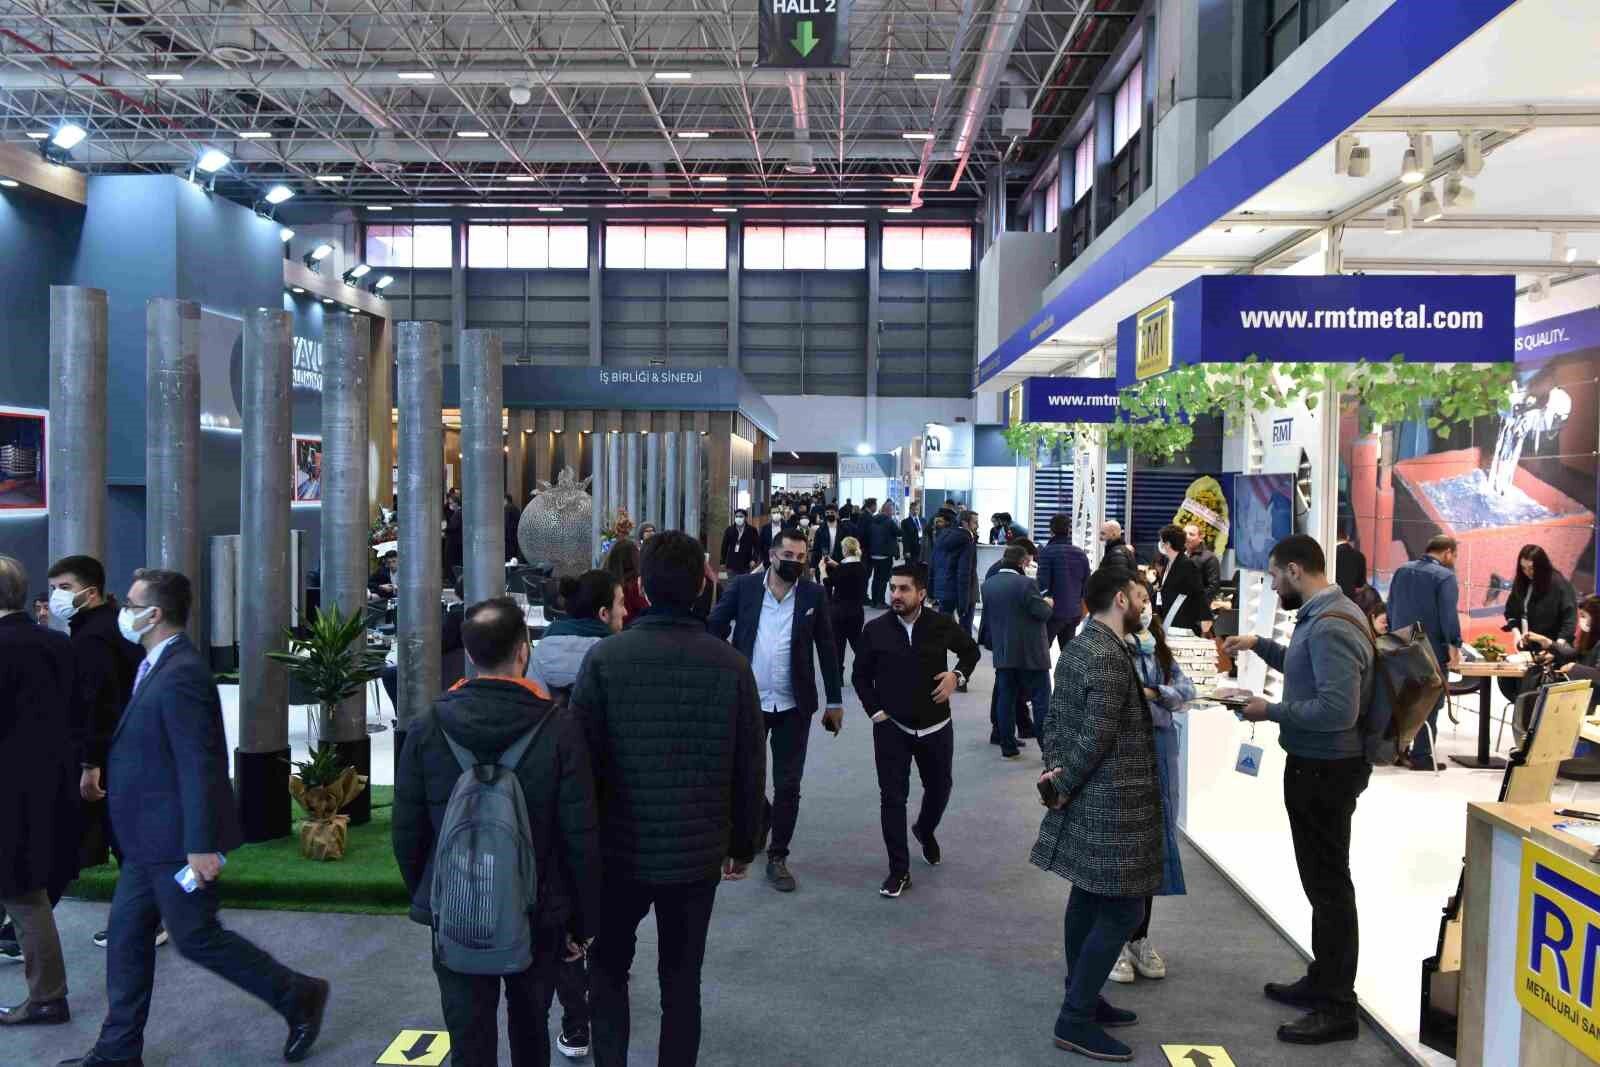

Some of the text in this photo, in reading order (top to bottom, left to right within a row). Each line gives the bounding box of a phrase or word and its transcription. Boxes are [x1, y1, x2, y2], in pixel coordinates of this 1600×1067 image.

[773, 0, 836, 13] HALL 2
[1240, 304, 1484, 329] www.rmtmetal.com
[651, 371, 660, 382] &
[661, 369, 704, 383] SİNERJİ
[1272, 417, 1294, 442] RMT
[1526, 977, 1579, 1025] METALURJİ
